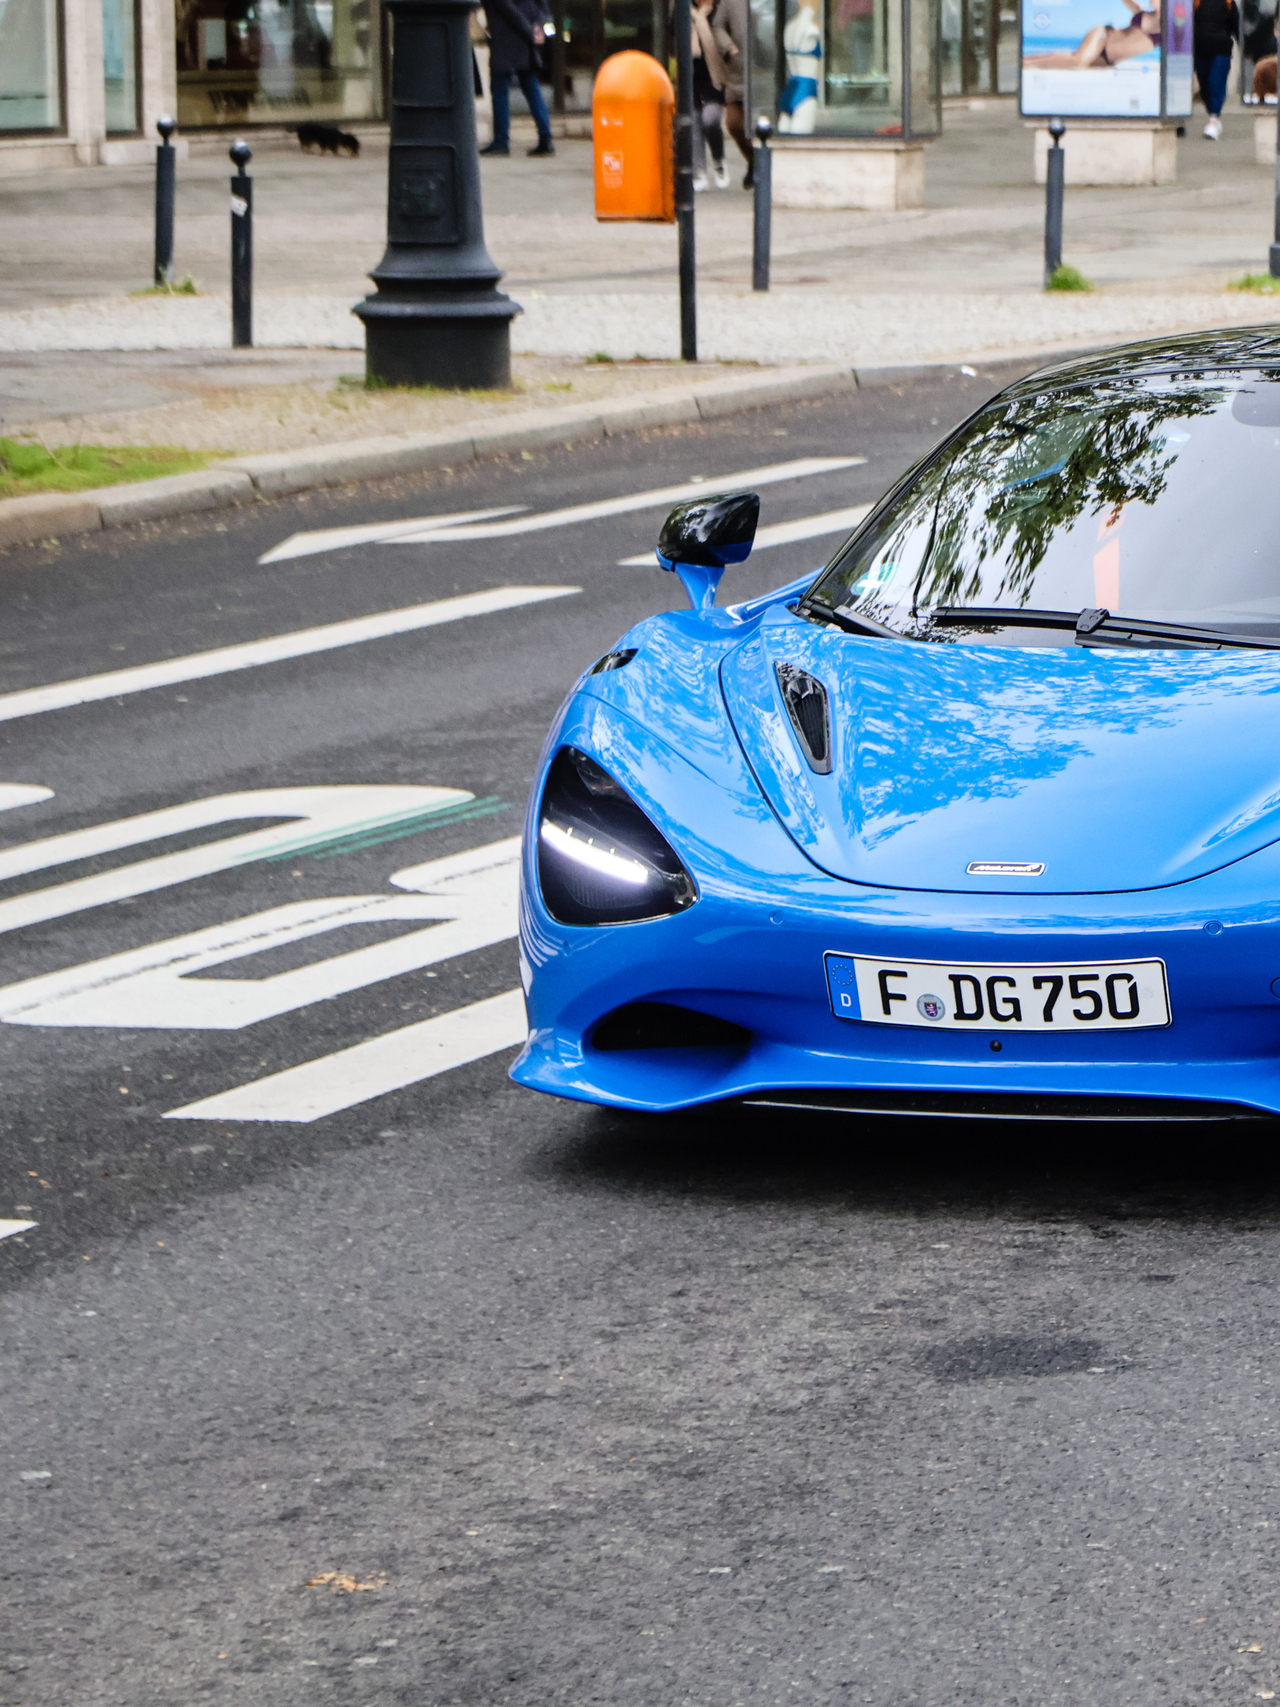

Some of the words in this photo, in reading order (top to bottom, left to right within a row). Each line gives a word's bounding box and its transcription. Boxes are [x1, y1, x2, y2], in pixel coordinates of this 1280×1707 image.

[841, 993, 852, 1008] D
[877, 969, 909, 1016] F
[948, 973, 1023, 1023] DG
[1032, 972, 1141, 1022] 750
